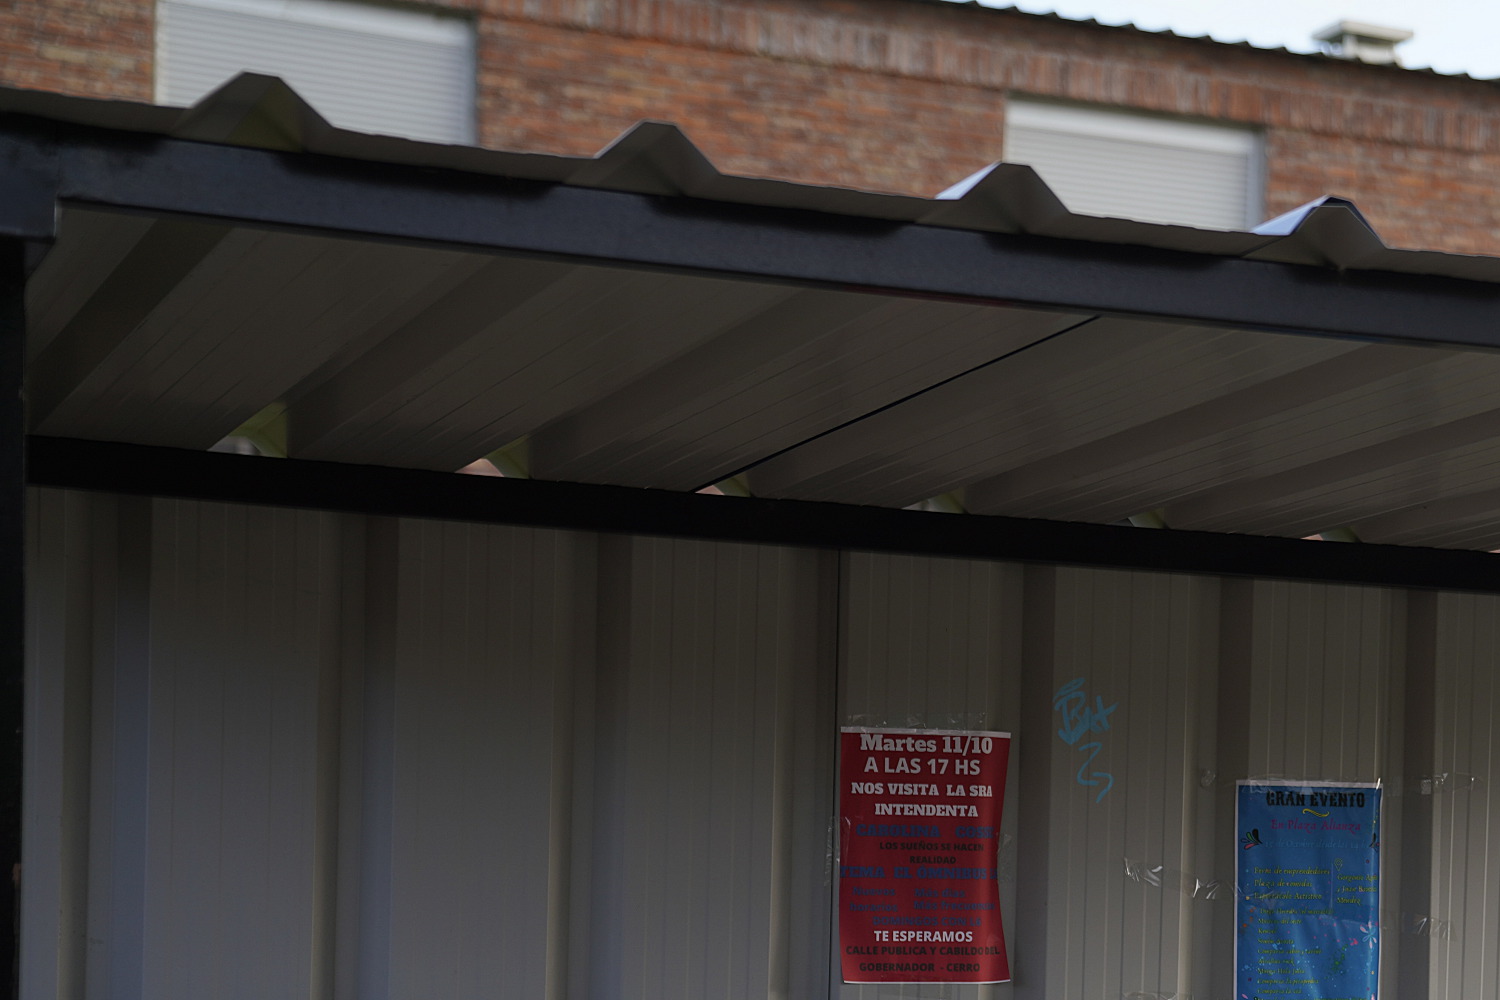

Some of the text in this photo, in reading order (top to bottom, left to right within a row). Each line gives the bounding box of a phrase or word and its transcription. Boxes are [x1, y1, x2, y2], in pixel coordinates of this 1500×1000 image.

[860, 733, 993, 756] Martes 11/10
[864, 756, 981, 776] A LAS 17 HS
[851, 782, 993, 798] NOS VISITA LA SRA
[1265, 790, 1366, 808] GRAN EVENTO
[874, 803, 979, 818] INTENDENTA
[856, 824, 941, 838] CAROLINA
[1271, 817, 1361, 834] En Plaza Alianza
[879, 840, 984, 852] LOS SUEÑOS SE HACEN
[909, 855, 957, 865] REALIDAD
[839, 865, 885, 879] TEMA
[917, 864, 987, 880] ÓMNIBUS
[1274, 865, 1282, 874] de
[1277, 878, 1285, 887] de
[851, 885, 896, 897] Nuevos
[872, 915, 938, 926] DOMINGOS
[941, 916, 967, 927] CON
[873, 930, 973, 943] TE ESPERAMOS
[846, 945, 1000, 956] CALLE PUBLICA Y CABILDO DEL
[859, 962, 935, 972] GOBERNADOR
[946, 962, 981, 972] CERRO
